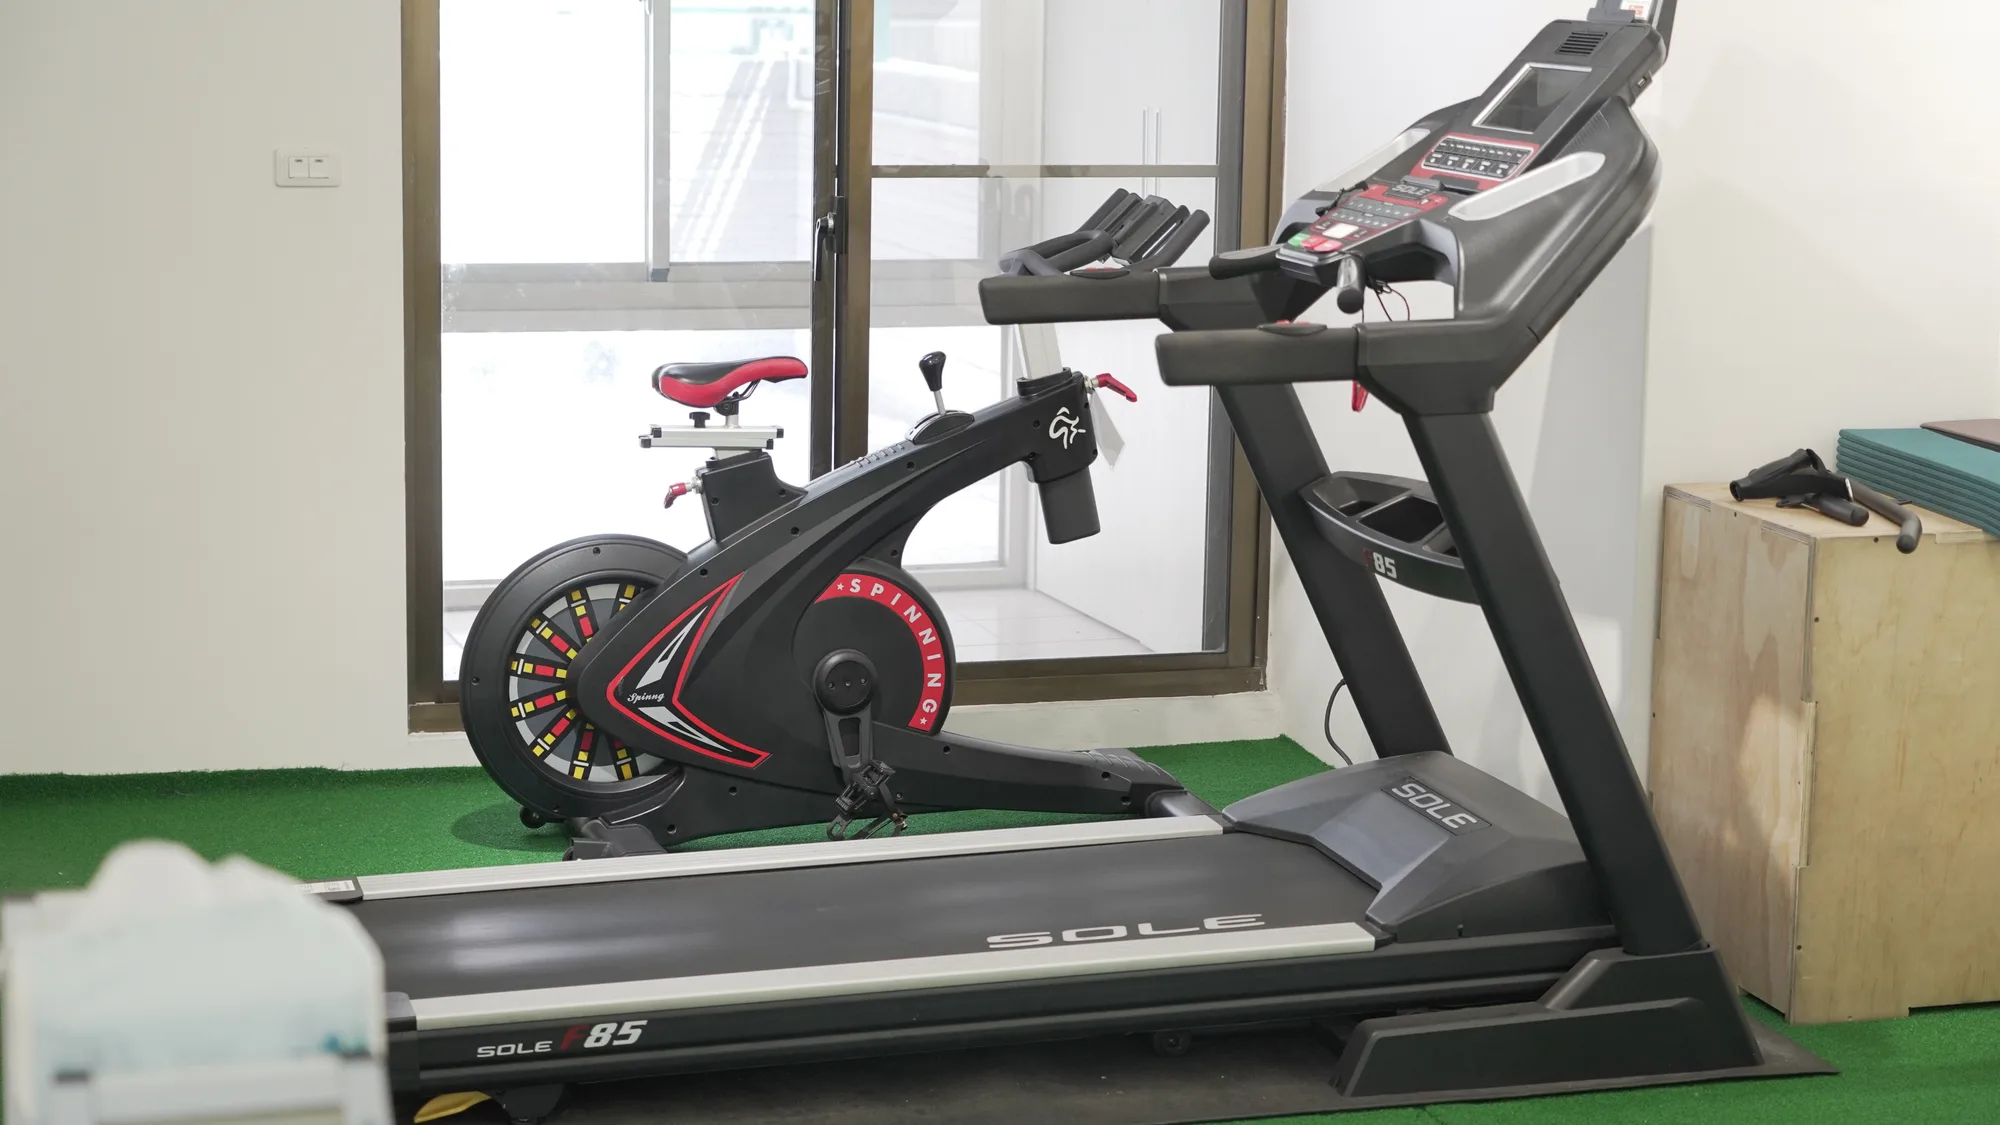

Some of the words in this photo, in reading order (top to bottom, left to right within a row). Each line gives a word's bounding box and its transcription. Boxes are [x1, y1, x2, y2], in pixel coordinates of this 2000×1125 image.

[849, 578, 942, 713] SPINNING
[1391, 783, 1478, 829] SOLE
[986, 913, 1266, 949] SOLE
[476, 1040, 553, 1058] SOLE
[559, 1020, 648, 1051] F85
